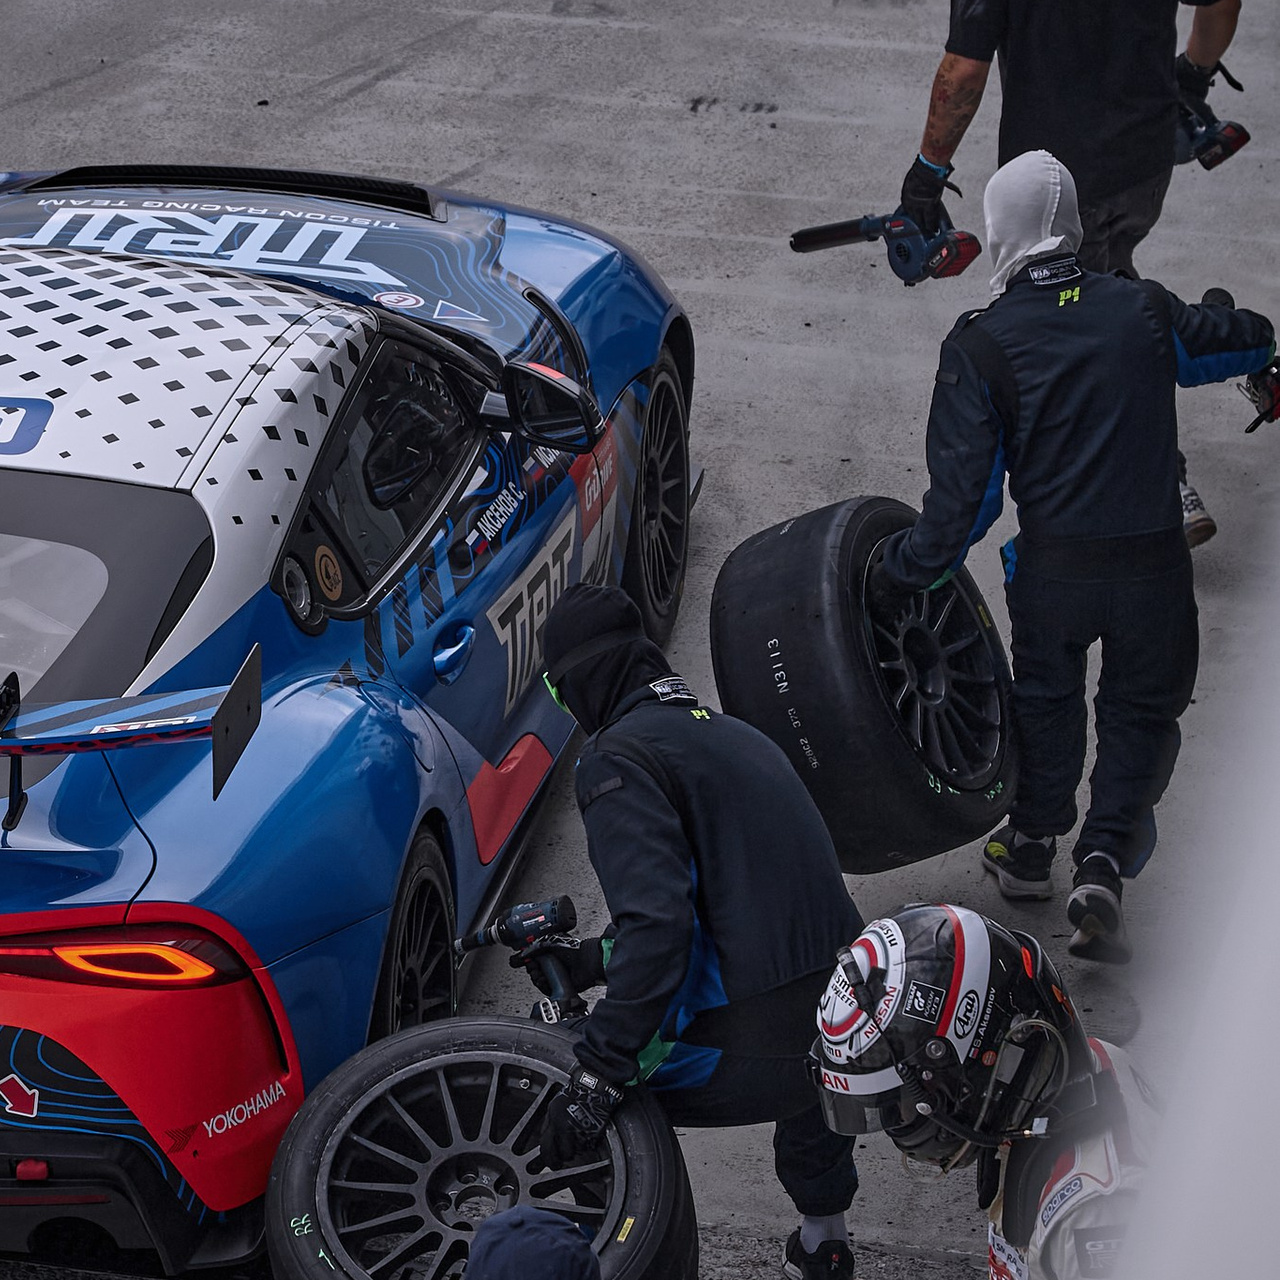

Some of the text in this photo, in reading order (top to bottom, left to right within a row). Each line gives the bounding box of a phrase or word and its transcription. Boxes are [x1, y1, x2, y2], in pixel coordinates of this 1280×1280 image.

[37, 199, 401, 230] TISCON RACING TEAM
[1058, 286, 1081, 308] P1
[476, 480, 527, 542] АКСЕНОВ С.
[767, 638, 790, 694] N3113
[864, 985, 897, 1040] NISSAN
[956, 992, 977, 1037] Arai
[202, 1080, 287, 1139] YOKOHAMA
[568, 1103, 592, 1129] OMP
[1041, 1178, 1082, 1222] sparco
[290, 1213, 314, 1237] RR
